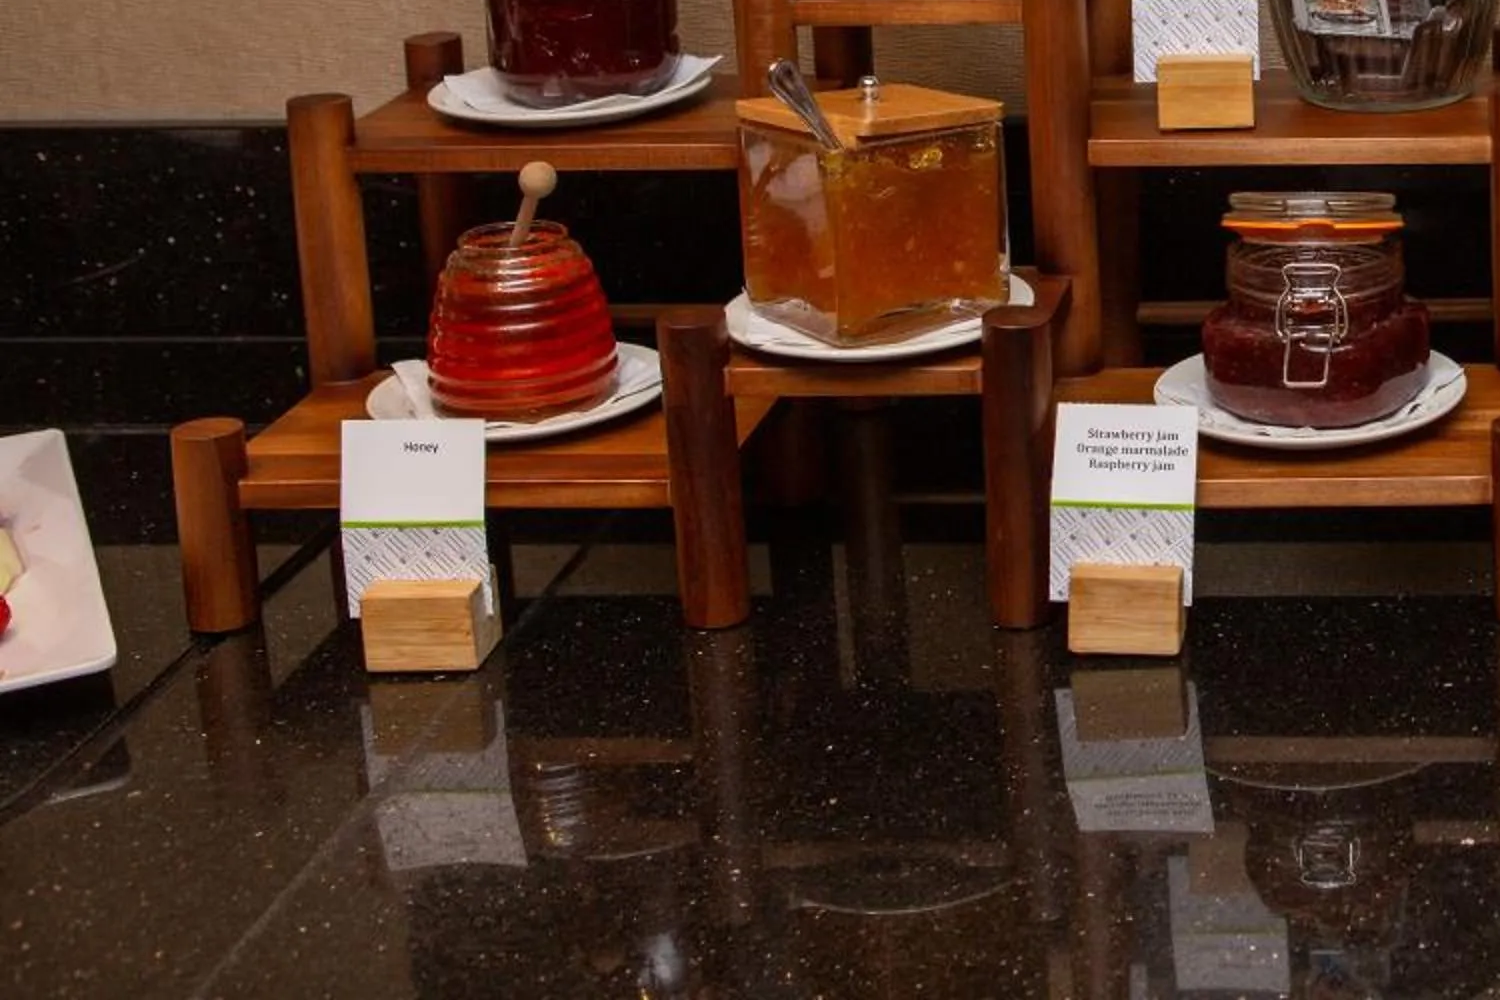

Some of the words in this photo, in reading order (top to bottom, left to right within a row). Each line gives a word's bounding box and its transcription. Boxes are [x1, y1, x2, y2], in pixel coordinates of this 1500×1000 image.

[1087, 428, 1153, 442] Strawberry
[403, 442, 439, 454] Honey
[1076, 443, 1118, 456] Orange
[1121, 445, 1189, 457] marmalade
[1089, 459, 1149, 472] Raspberry
[1151, 460, 1175, 472] jam
